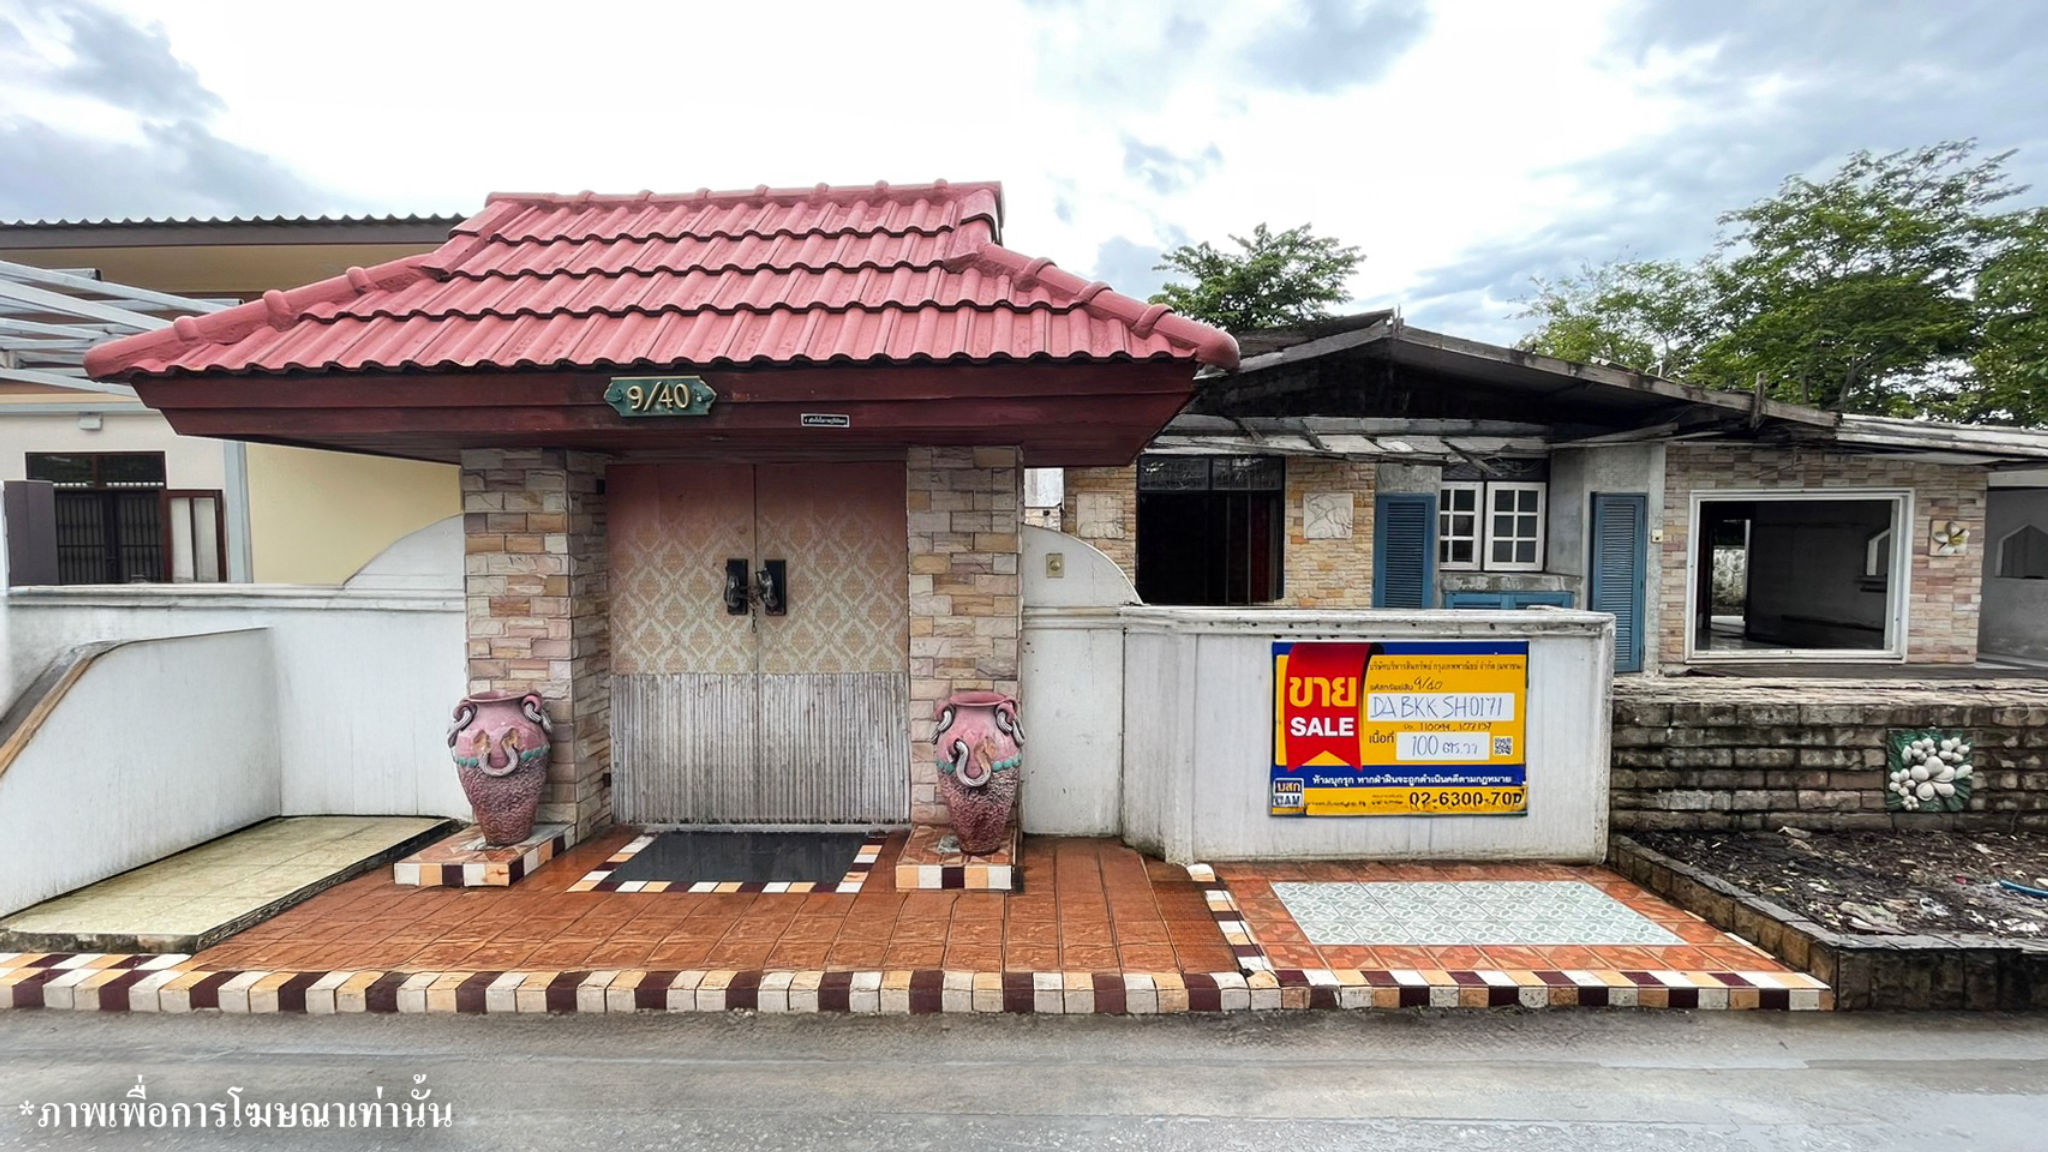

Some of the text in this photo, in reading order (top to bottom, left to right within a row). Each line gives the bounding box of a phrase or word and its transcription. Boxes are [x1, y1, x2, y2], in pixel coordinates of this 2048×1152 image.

[626, 381, 691, 411] 9/40
[1289, 676, 1357, 708] ขาย
[1290, 717, 1355, 738] SALE
[1369, 730, 1394, 744] เนื้อที่
[1411, 735, 1438, 757] 100
[1312, 774, 1354, 787] ห้ามบุกรุก
